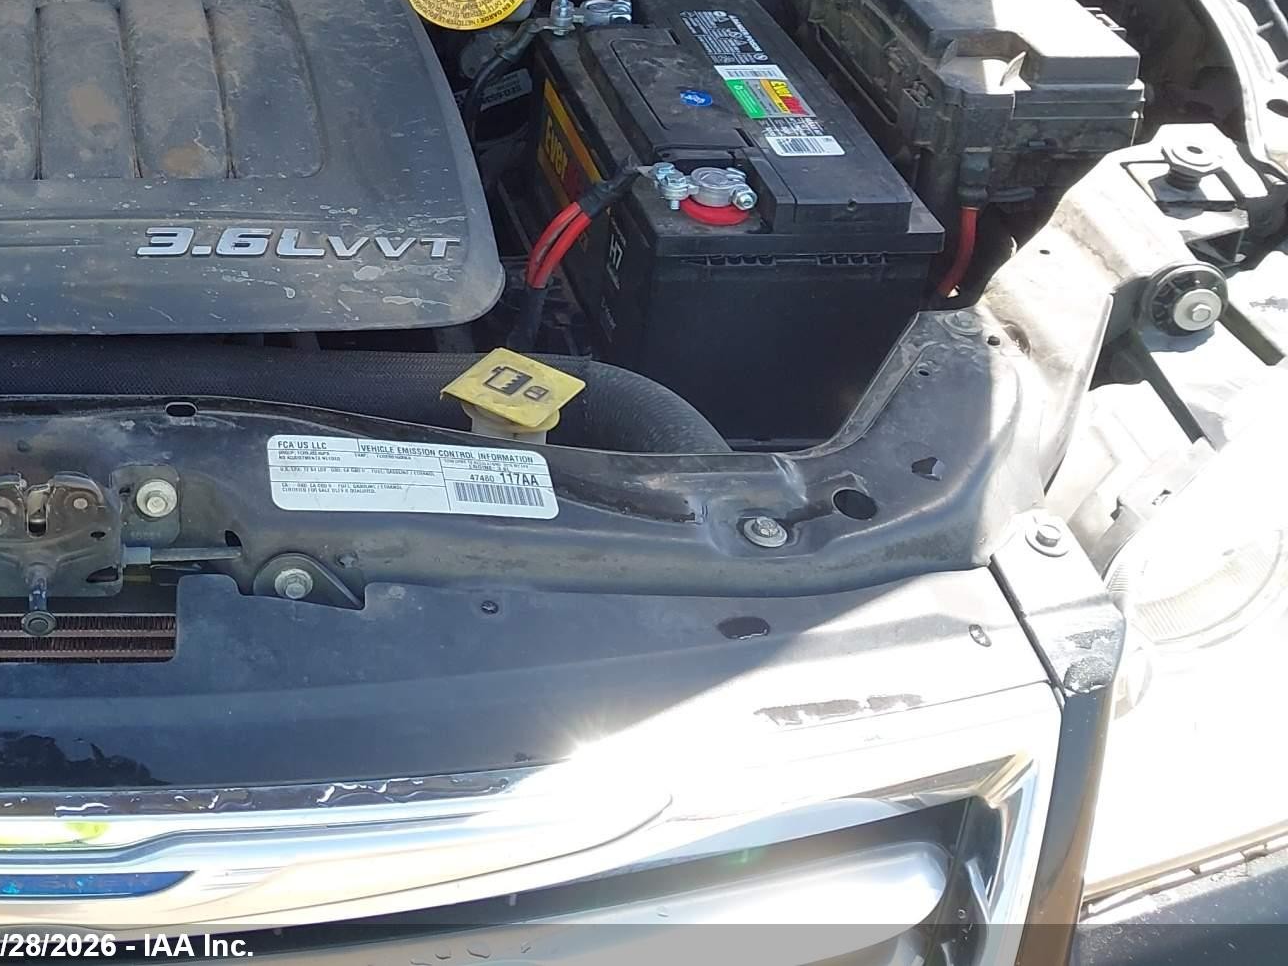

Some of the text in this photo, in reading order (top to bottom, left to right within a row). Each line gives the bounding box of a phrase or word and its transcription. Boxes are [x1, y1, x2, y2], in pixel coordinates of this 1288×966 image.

[311, 442, 327, 450] LLC
[361, 445, 394, 454] VEHICLE
[397, 447, 435, 456] EMISSION
[438, 450, 474, 459] CONTROL
[478, 452, 534, 463] INFORMATION
[470, 472, 540, 487] 47480 117AA
